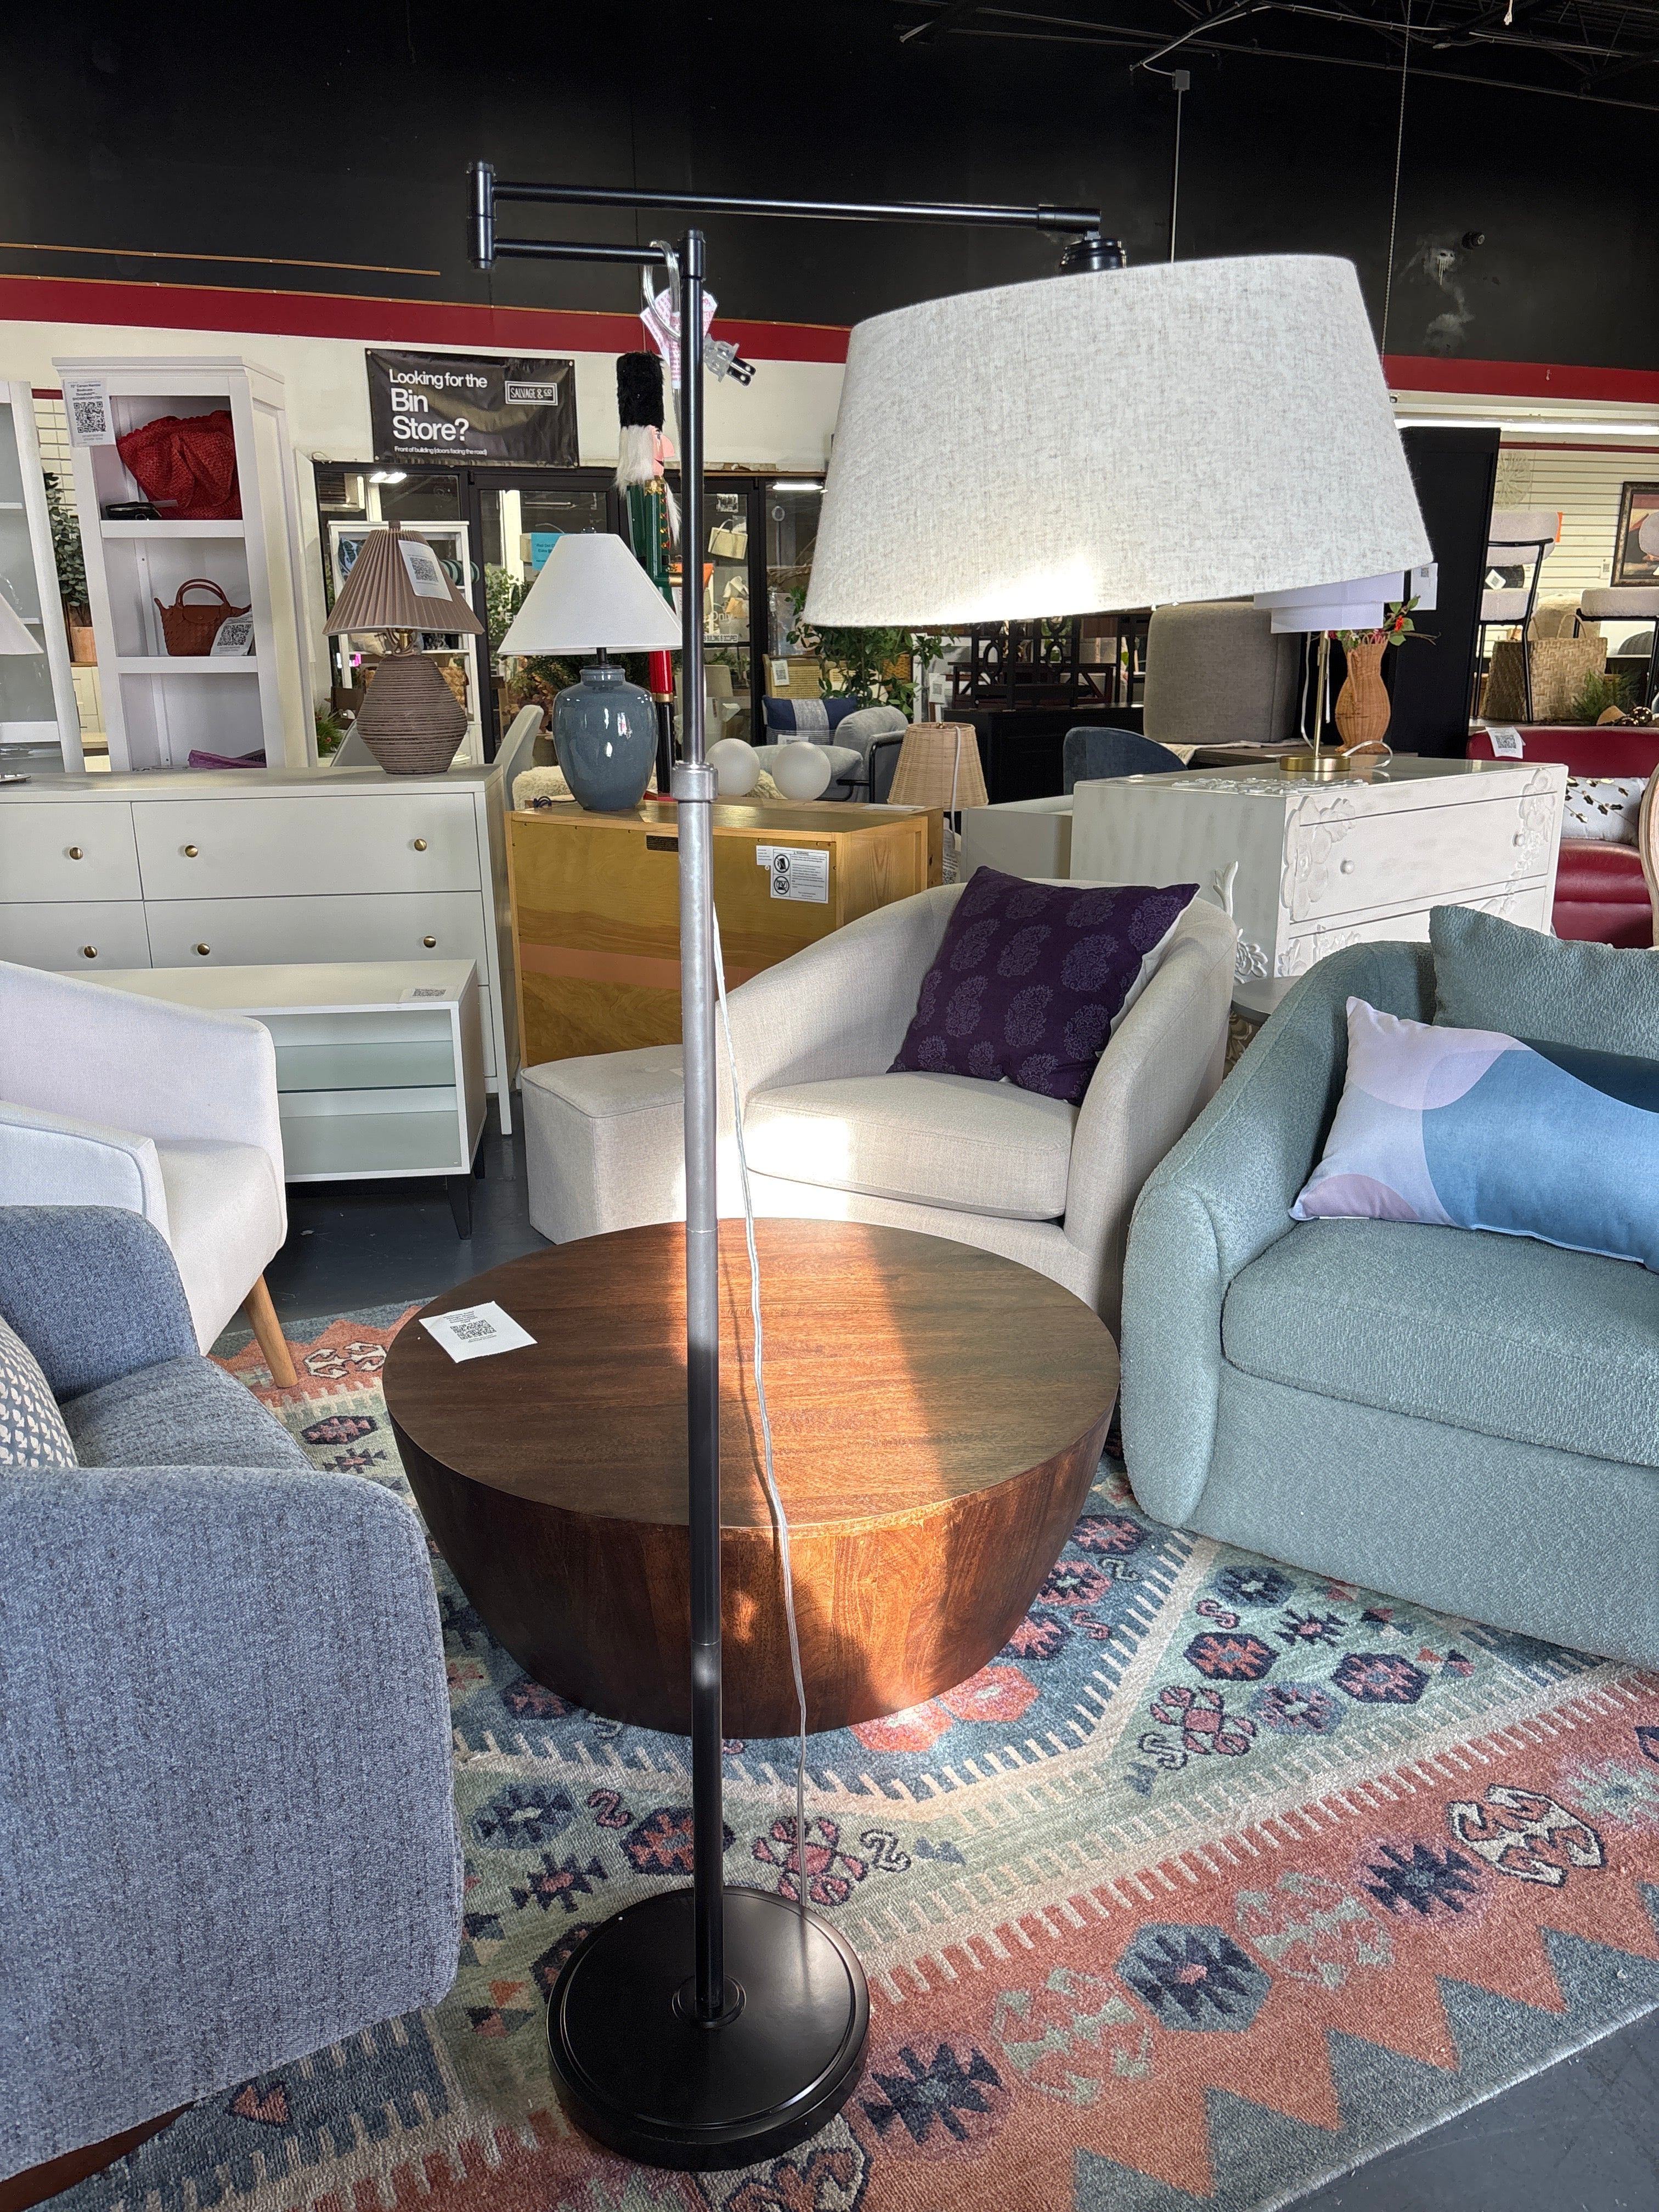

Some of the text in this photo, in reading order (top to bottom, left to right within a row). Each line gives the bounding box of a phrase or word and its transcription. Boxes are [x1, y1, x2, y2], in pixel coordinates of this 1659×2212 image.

[389, 369, 488, 390] Looking for the
[391, 387, 428, 413] Bin
[510, 387, 537, 399] SALVAGE
[537, 388, 544, 399] &
[393, 415, 470, 441] Store?
[414, 447, 434, 455] building
[711, 611, 733, 624] Only
